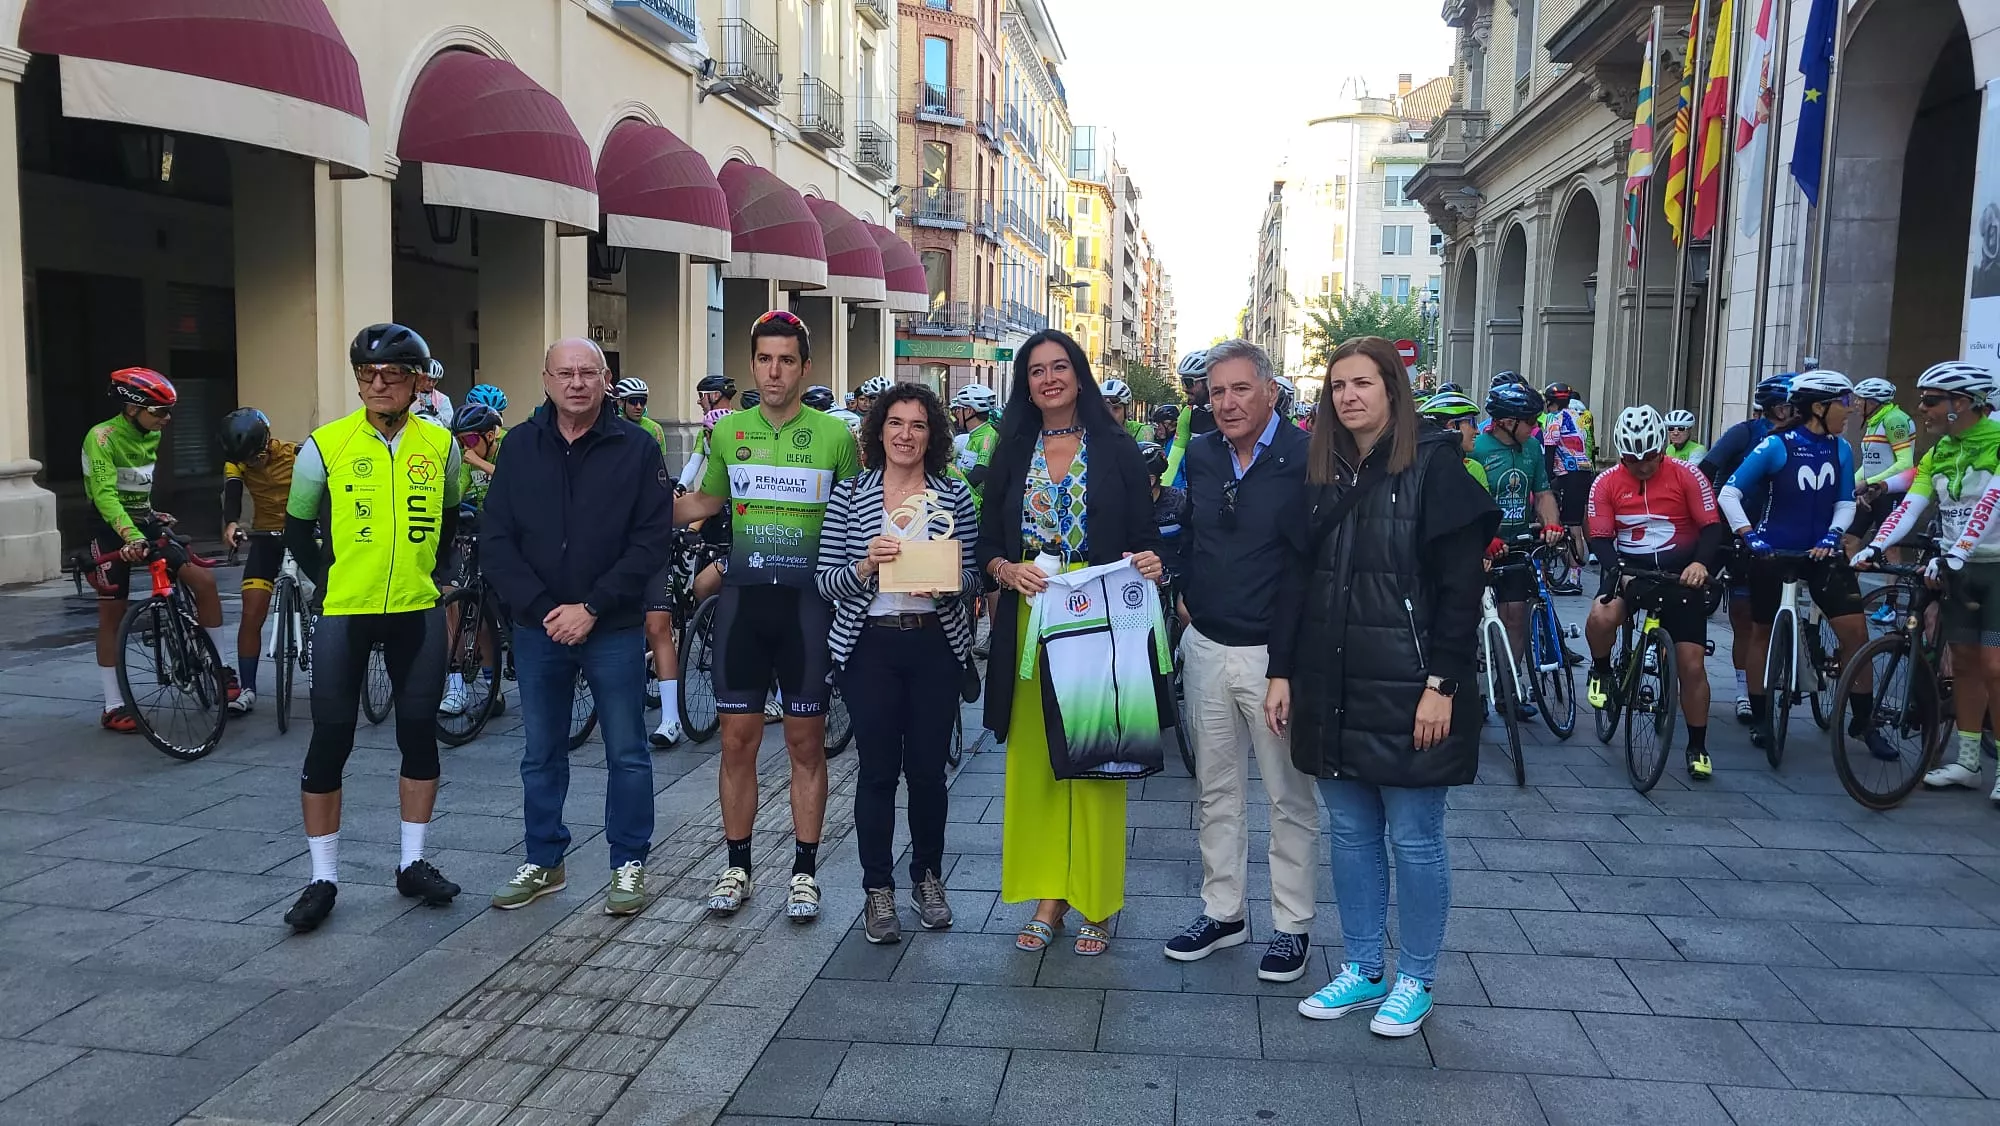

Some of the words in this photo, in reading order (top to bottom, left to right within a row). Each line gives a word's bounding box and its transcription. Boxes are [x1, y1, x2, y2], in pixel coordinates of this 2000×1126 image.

[755, 475, 807, 487] RENAULT
[777, 485, 807, 494] CUATRO
[1878, 500, 1913, 540] HUESCA
[791, 702, 821, 713] ULEVEL
